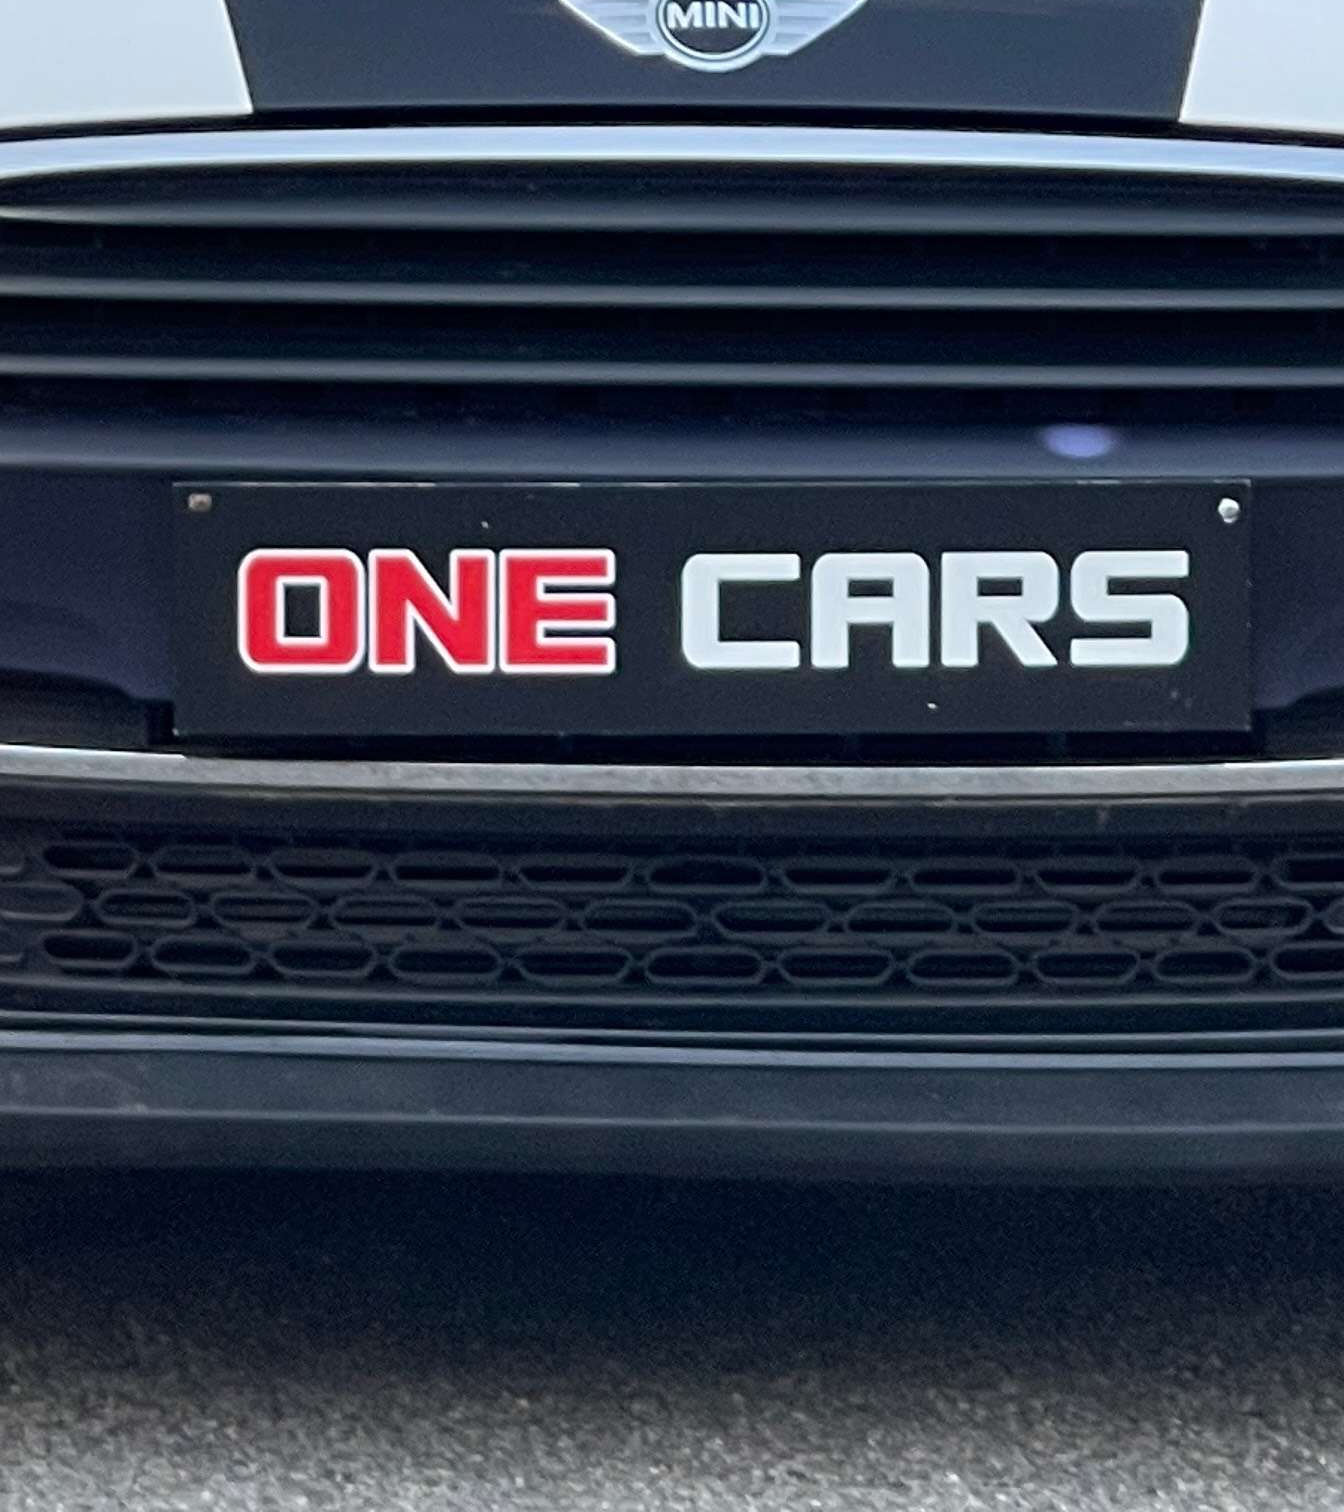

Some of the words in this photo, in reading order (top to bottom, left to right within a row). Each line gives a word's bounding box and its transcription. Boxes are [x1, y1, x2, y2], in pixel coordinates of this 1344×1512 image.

[667, 1, 758, 29] MINI
[238, 548, 616, 673] ONE
[681, 550, 1190, 669] CARS
